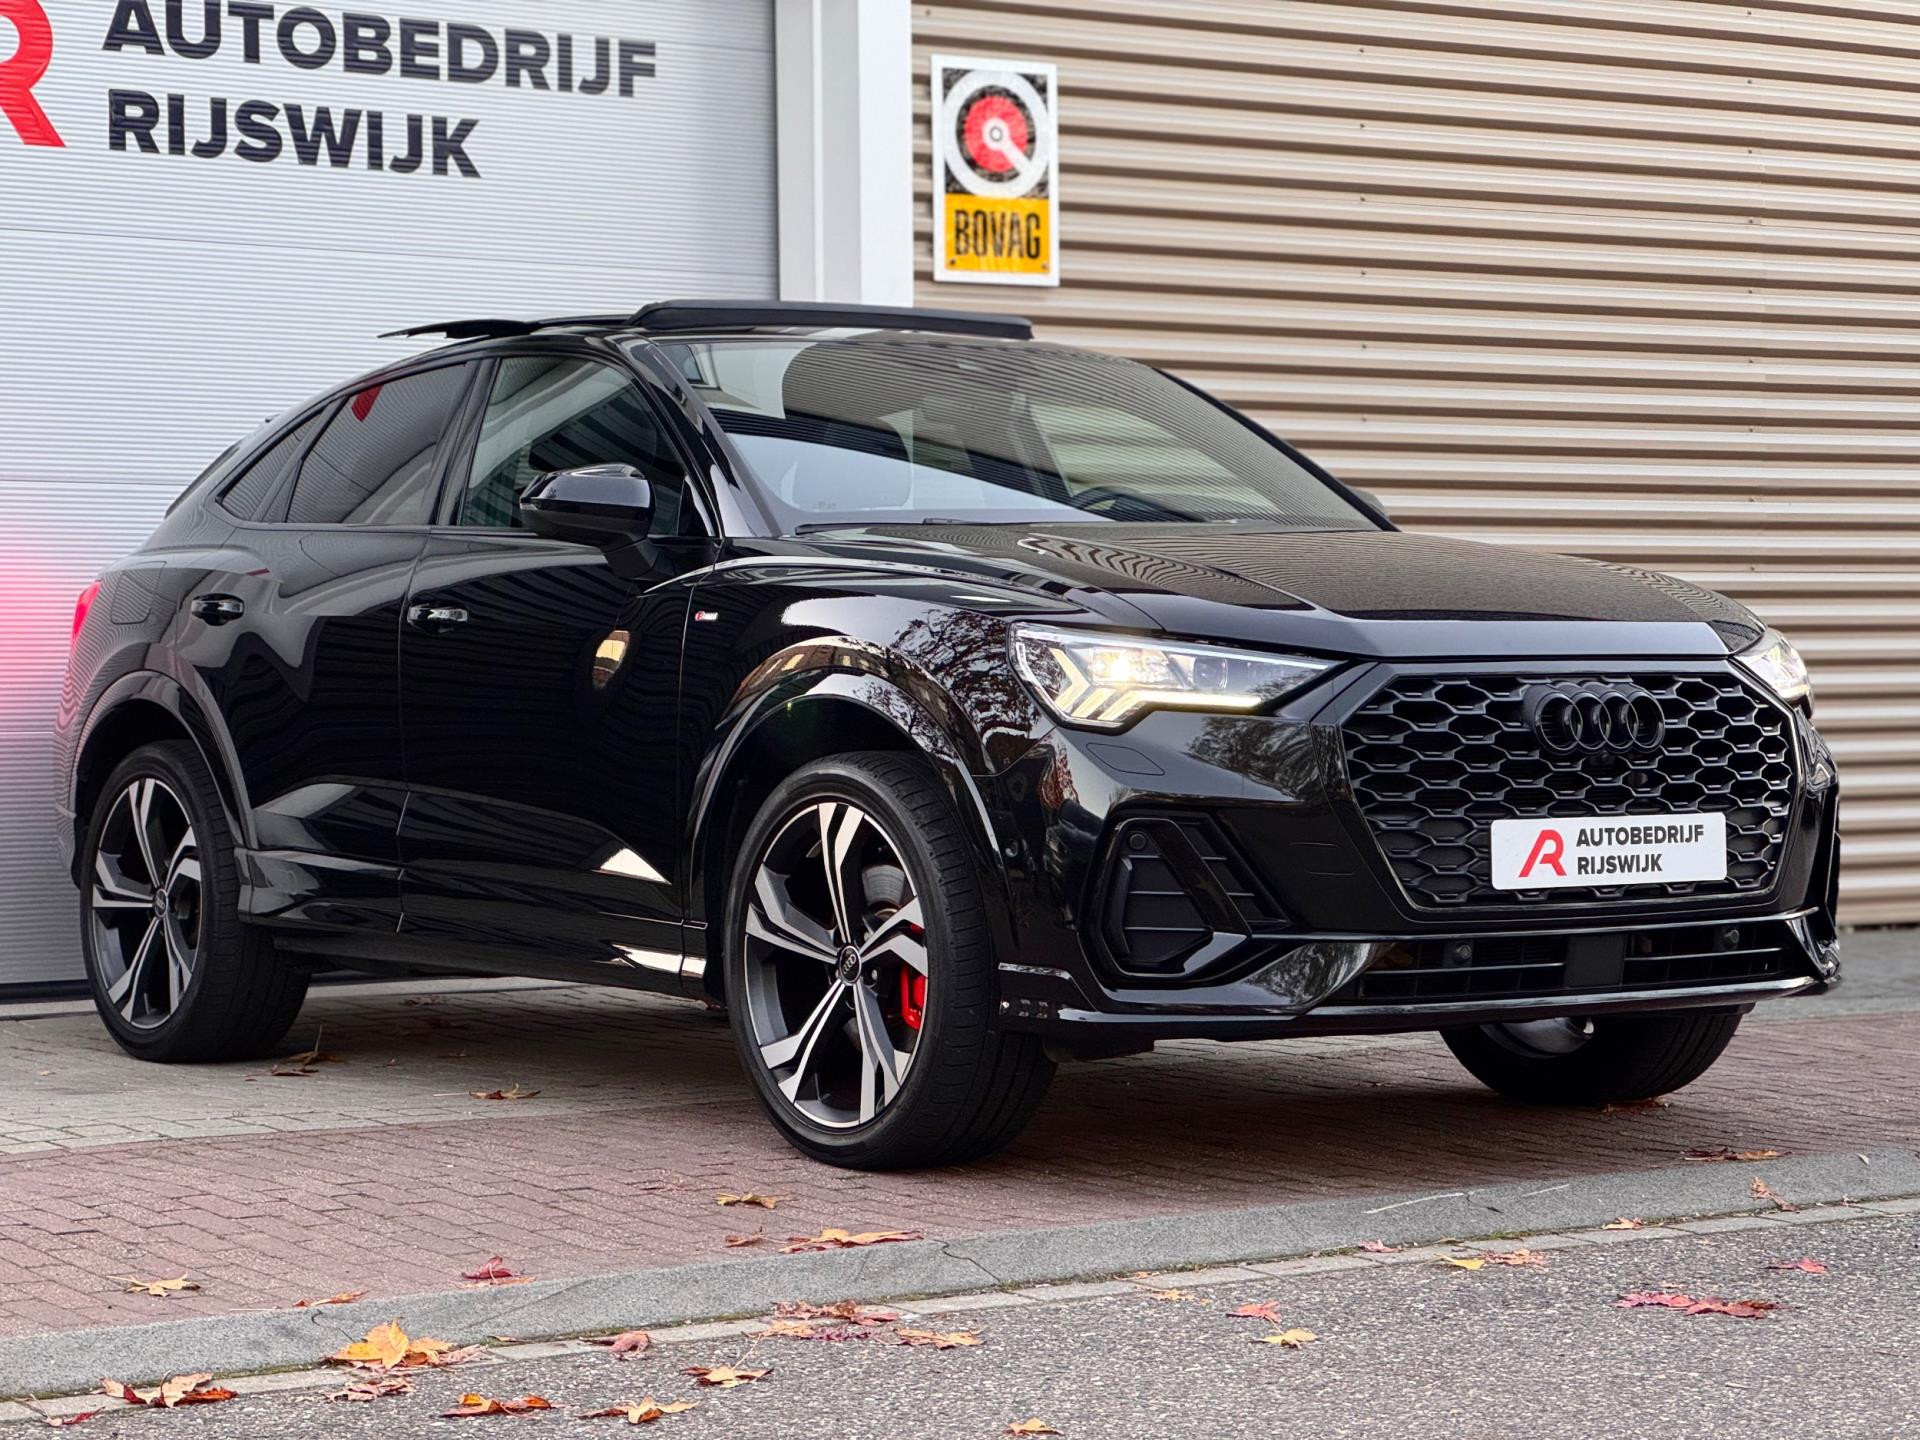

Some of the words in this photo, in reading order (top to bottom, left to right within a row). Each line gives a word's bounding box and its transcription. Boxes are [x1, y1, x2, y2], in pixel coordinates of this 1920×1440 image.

[102, 0, 656, 98] AUTOBEDRIJF
[108, 88, 482, 178] RIJSWIJK
[954, 209, 1041, 260] BOVAG
[1576, 824, 1704, 847] AUTOBEDRIJF
[1577, 853, 1663, 875] RIJSWIJK
